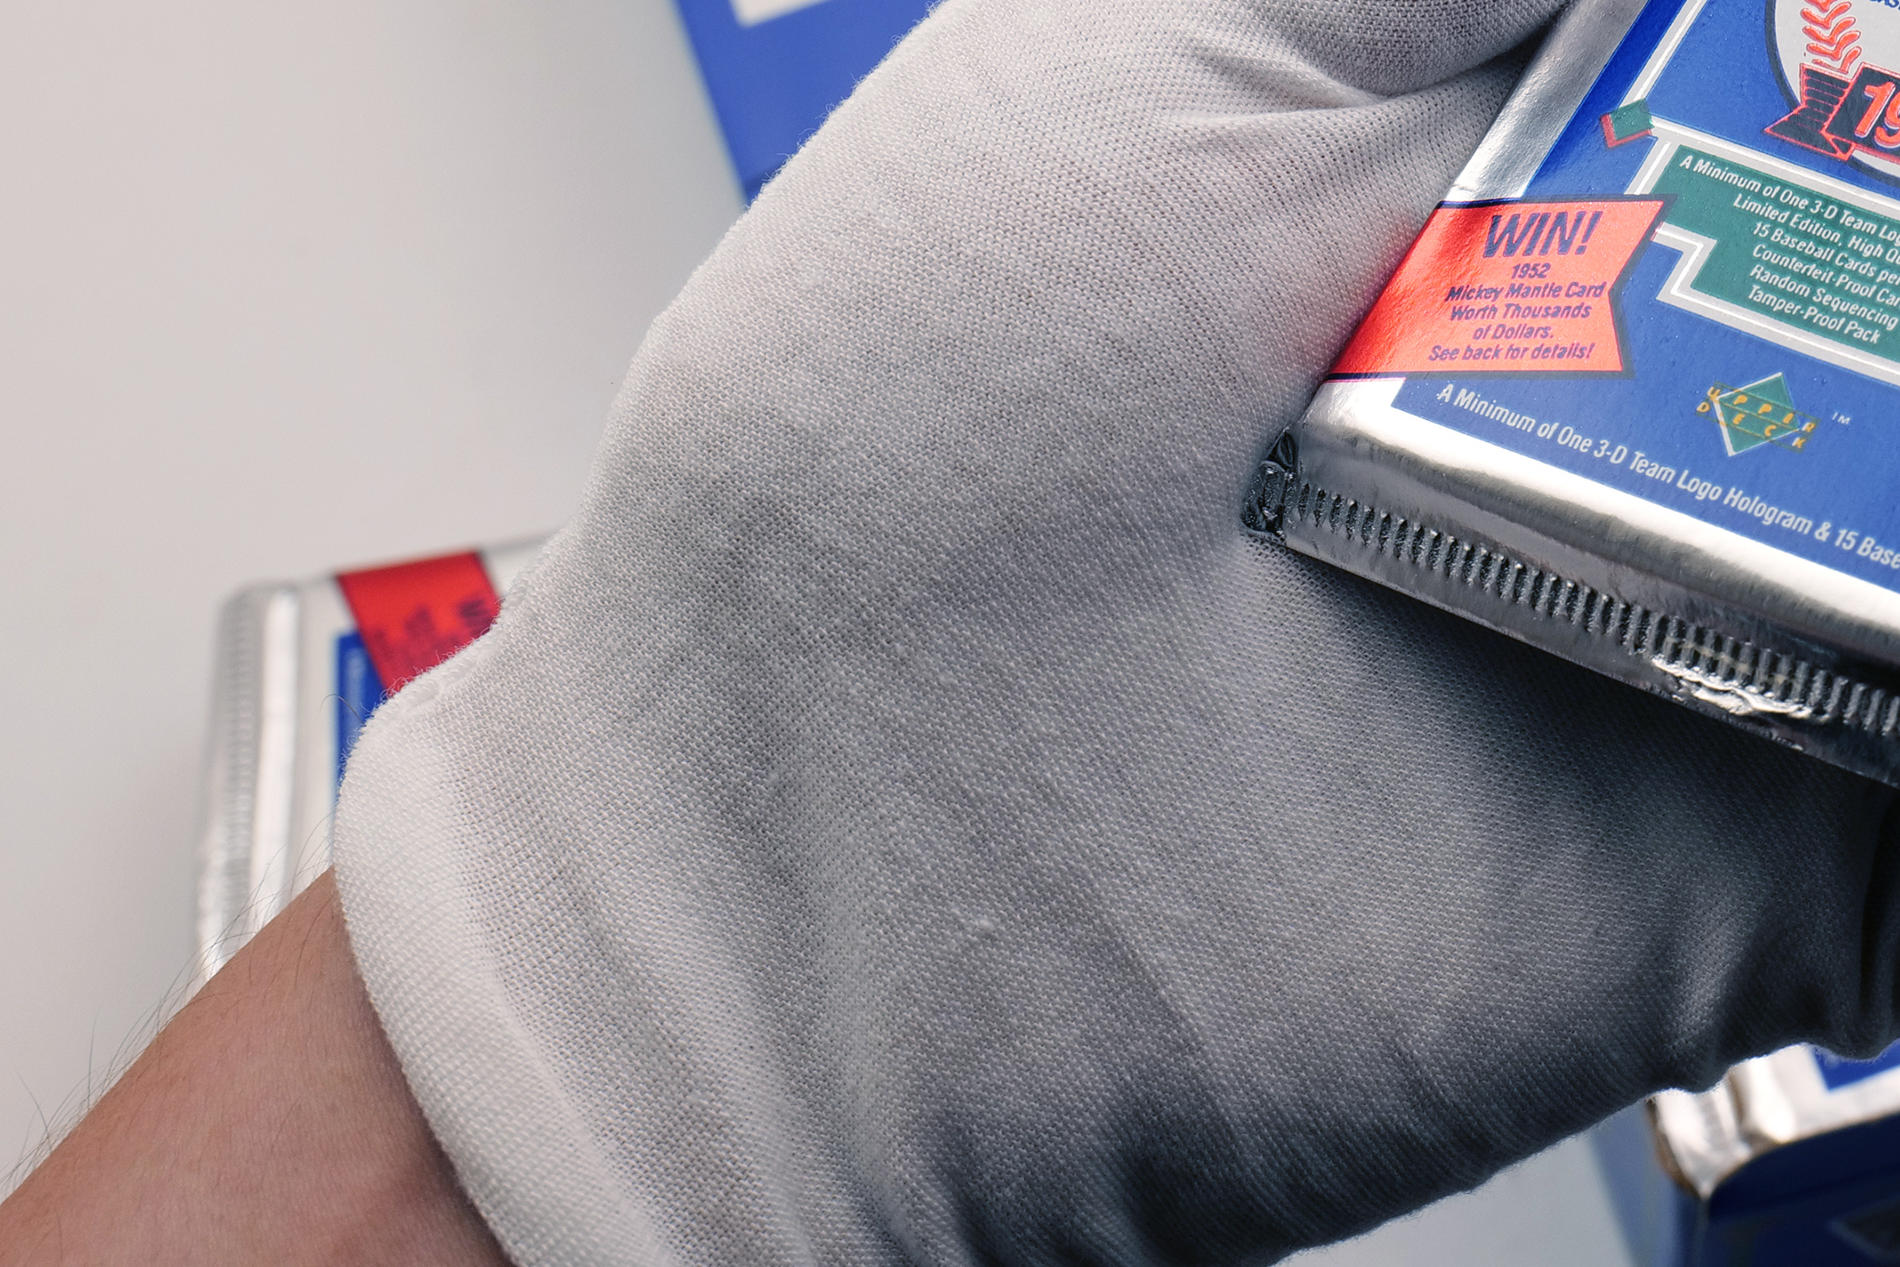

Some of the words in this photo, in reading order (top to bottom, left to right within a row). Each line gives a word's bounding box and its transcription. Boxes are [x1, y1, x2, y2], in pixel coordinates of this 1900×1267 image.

[1679, 155, 1693, 169] A
[1693, 159, 1760, 193] Minimum
[1762, 186, 1780, 198] of
[1779, 190, 1809, 210] One
[1809, 201, 1838, 219] 3-D
[1840, 210, 1877, 235] Team
[1483, 210, 1603, 259] WIN!
[1733, 194, 1790, 222] Limited
[1789, 215, 1842, 246] Edition,
[1848, 236, 1884, 260] High
[1752, 222, 1770, 238] 15
[1770, 229, 1836, 262] Baseball
[1835, 253, 1877, 277] Cards
[1445, 284, 1504, 302] Mickey
[1504, 282, 1562, 298] Mantle
[1565, 281, 1607, 298] Card
[1511, 263, 1551, 279] 1952
[1752, 244, 1874, 299] Counterfeit-Proof
[1450, 305, 1498, 321] Worth
[1503, 302, 1592, 319] Thousands
[1748, 285, 1845, 331] Tamper-Proof
[1844, 321, 1881, 344] Pack
[1750, 264, 1811, 297] Random
[1812, 288, 1899, 331] Sequencing
[1428, 345, 1459, 361] See
[1462, 344, 1503, 360] back
[1505, 343, 1529, 360] for
[1531, 343, 1595, 359] details!
[1472, 324, 1492, 340] of
[1493, 323, 1554, 339] Dollars.
[1696, 401, 1806, 449] DECK
[1707, 386, 1816, 433] UPPER
[1437, 384, 1454, 402] A
[1453, 388, 1536, 433] Minimum
[1537, 422, 1559, 440] of
[1556, 427, 1592, 453] One
[1593, 439, 1628, 464] 3-D
[1629, 451, 1676, 484] Team
[1677, 469, 1722, 500] Logo
[1722, 487, 1813, 535] Hologram
[1814, 522, 1832, 542] &
[1835, 528, 1860, 551] 15
